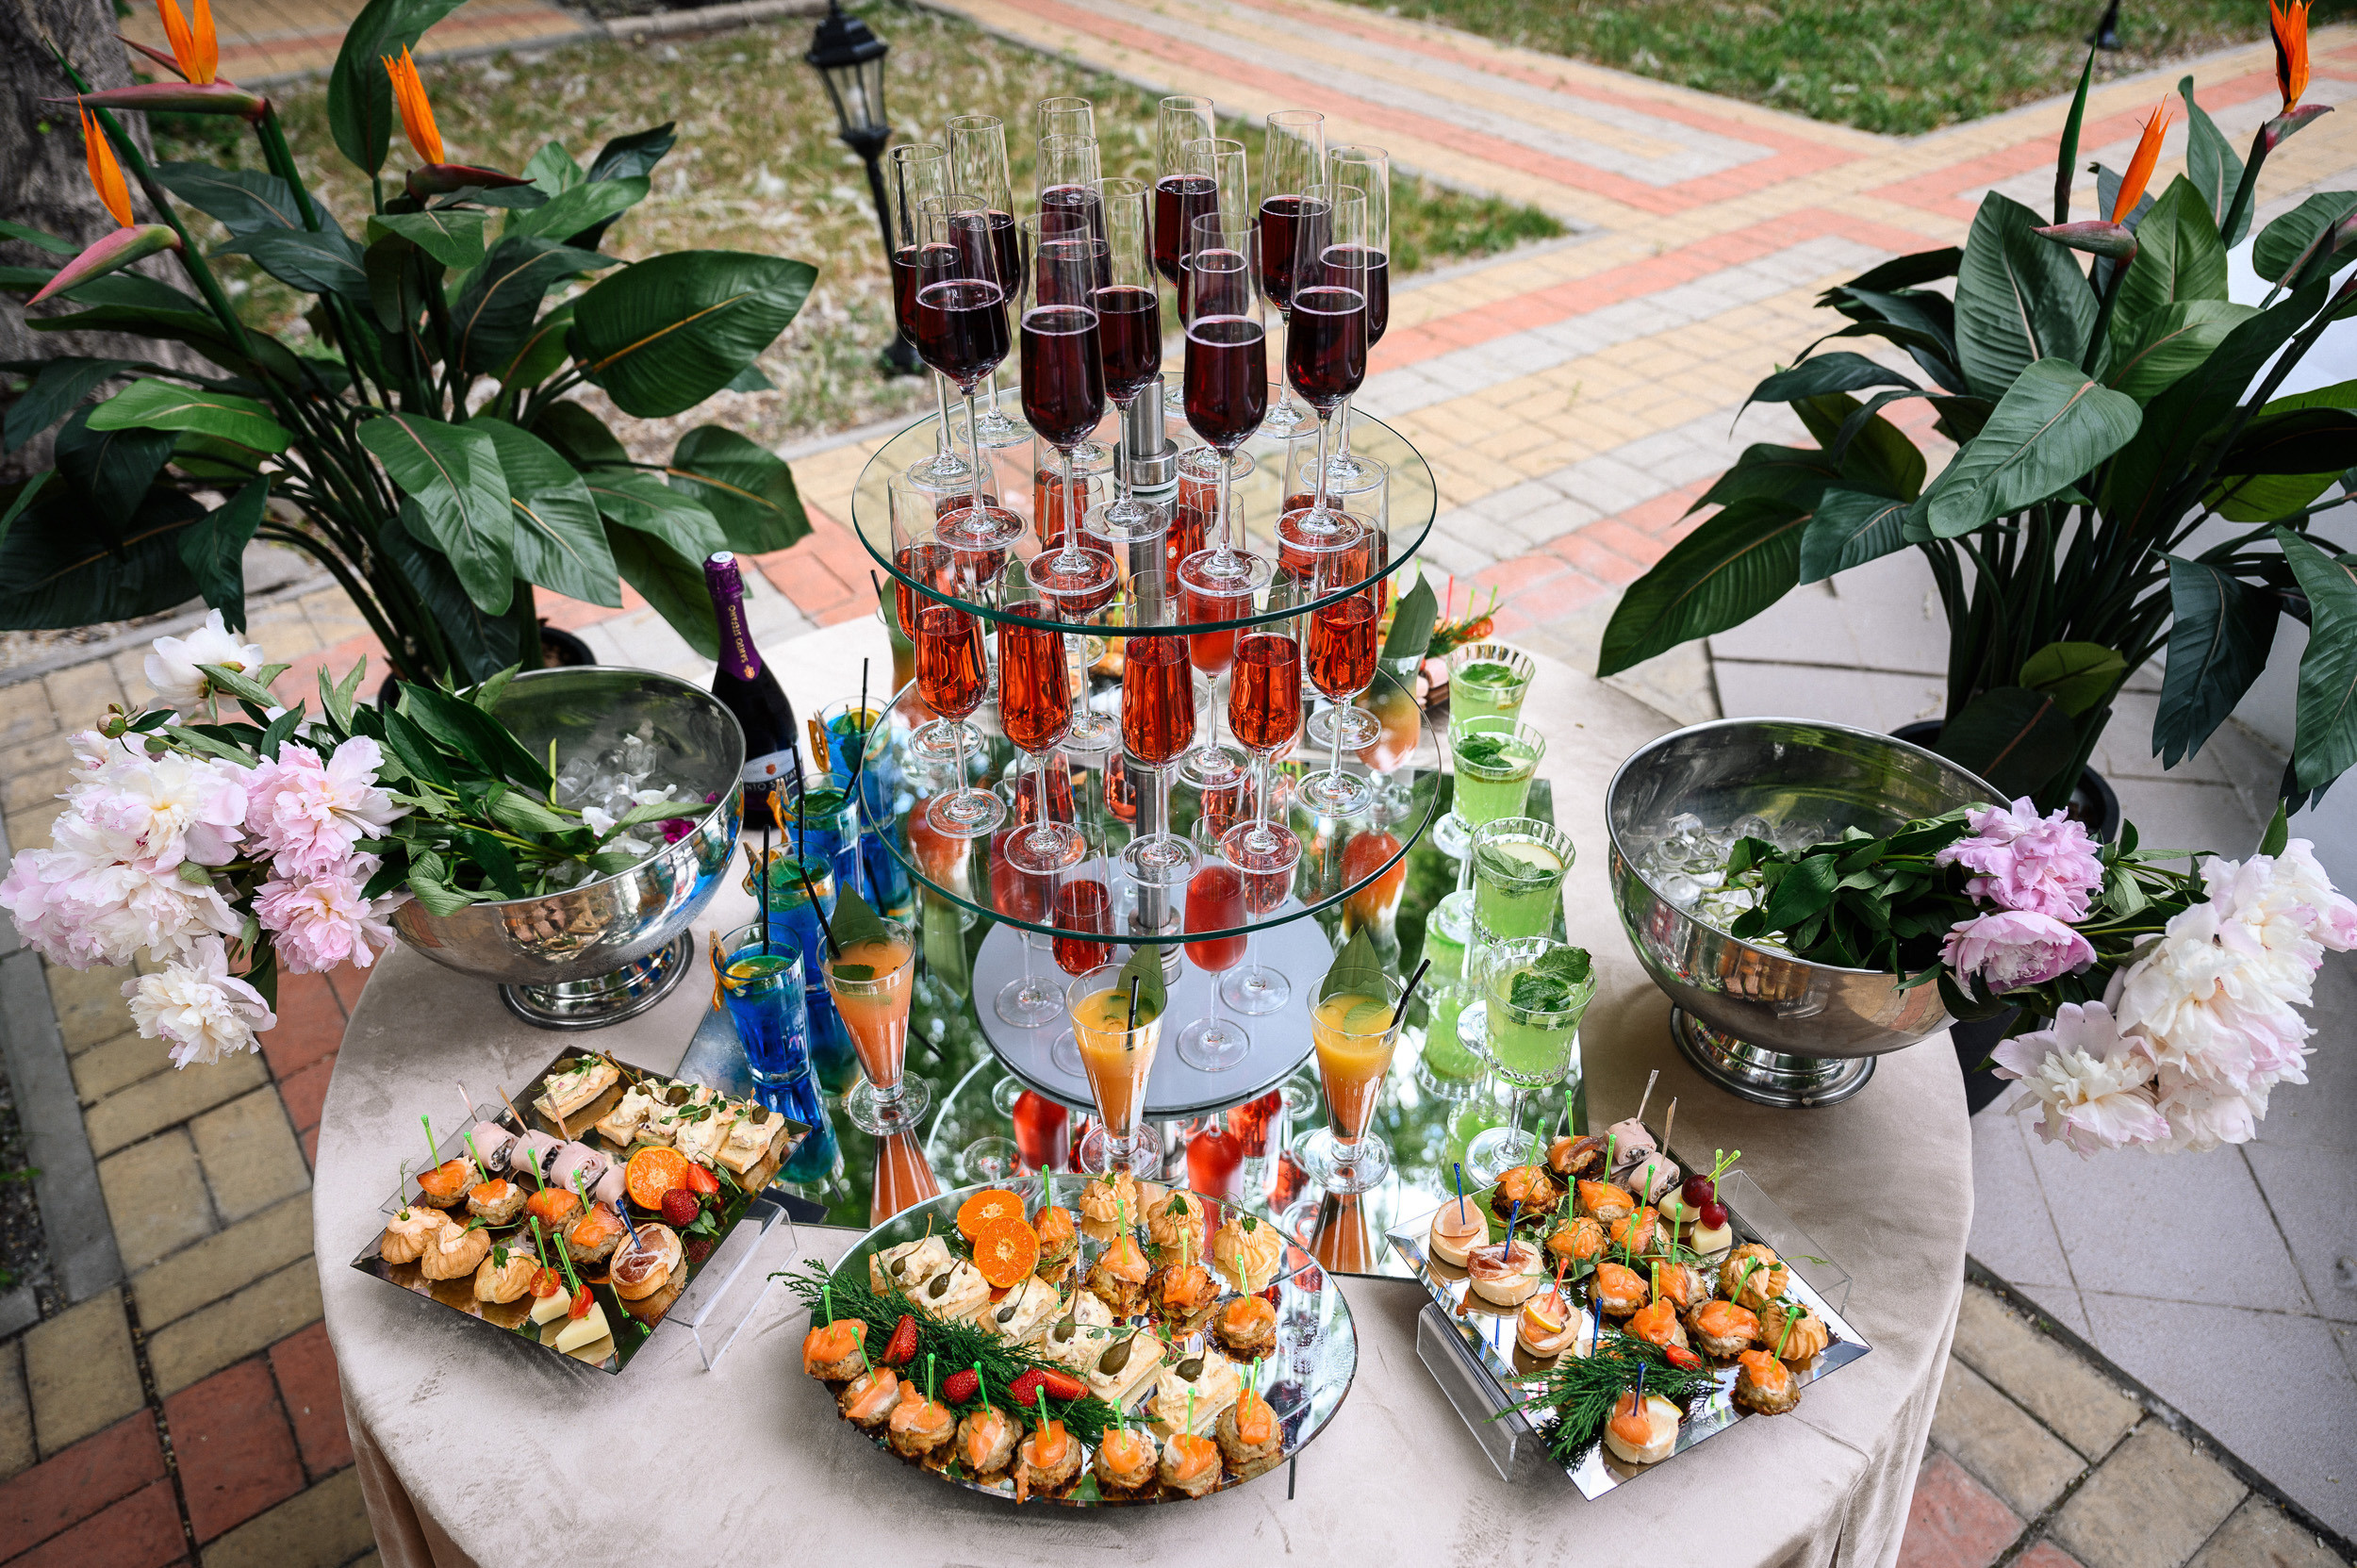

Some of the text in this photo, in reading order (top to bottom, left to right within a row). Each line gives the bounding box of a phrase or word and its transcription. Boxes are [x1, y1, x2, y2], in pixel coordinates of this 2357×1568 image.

[728, 604, 749, 664] SANTO STEFANO
[746, 782, 766, 791] NTO
